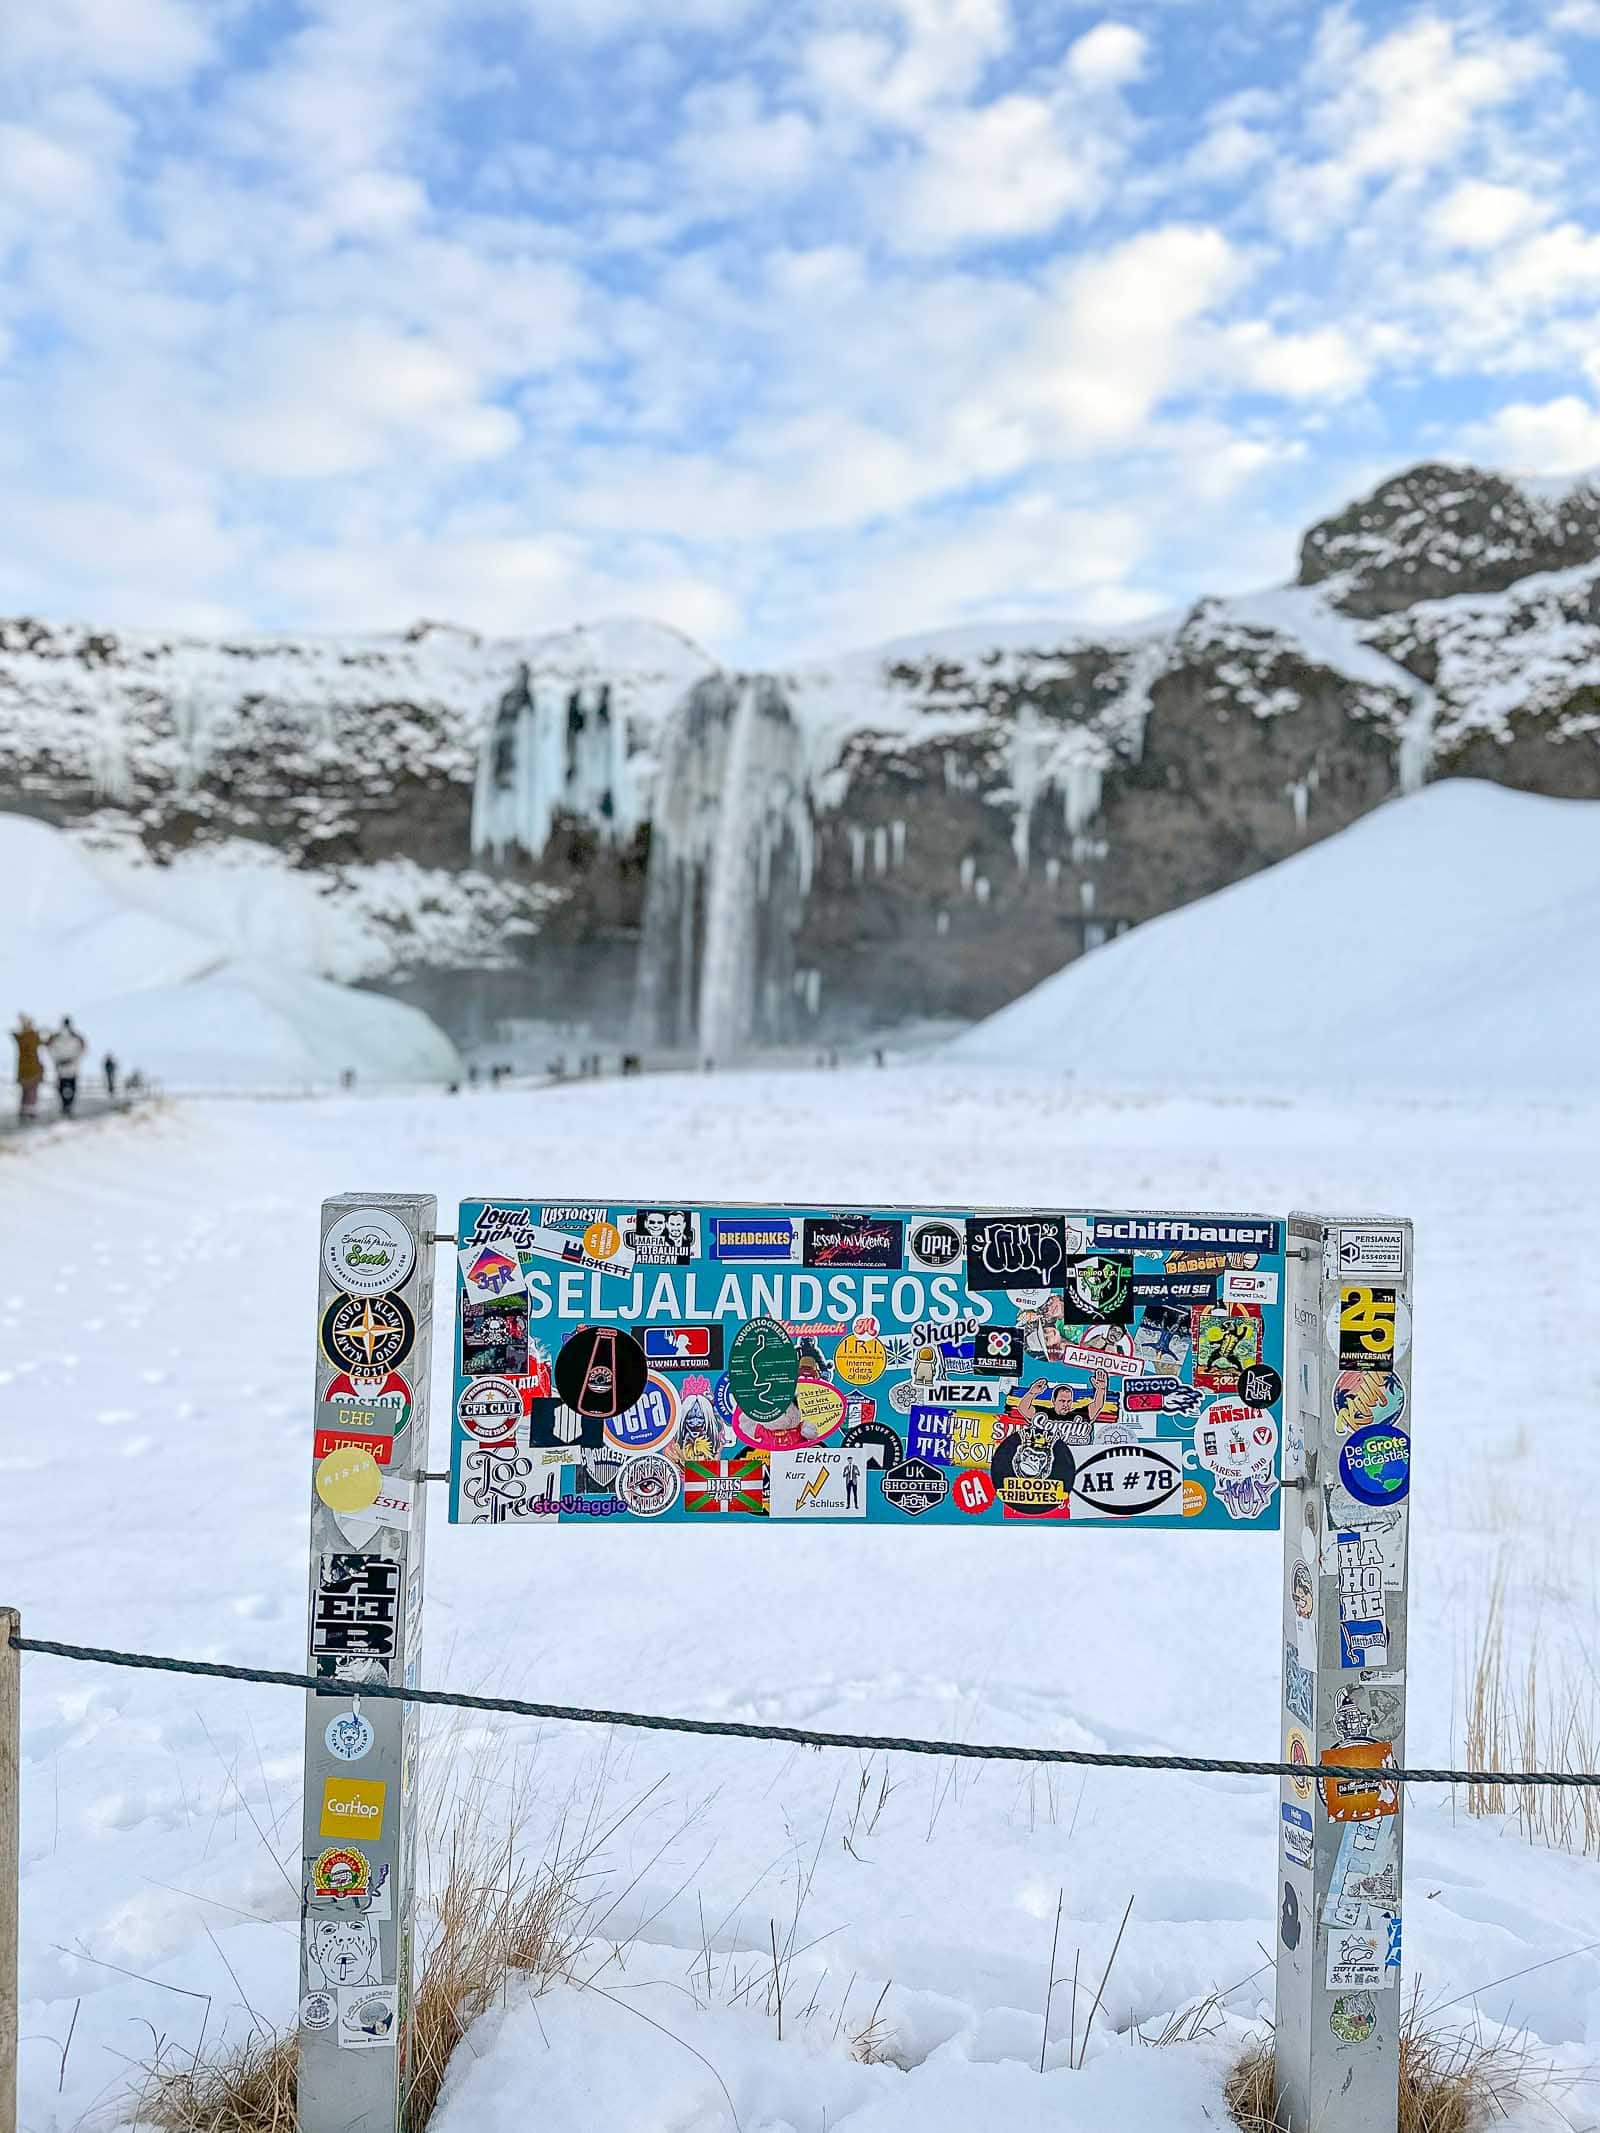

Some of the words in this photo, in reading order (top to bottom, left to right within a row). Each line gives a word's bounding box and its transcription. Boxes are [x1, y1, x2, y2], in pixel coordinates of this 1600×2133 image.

[476, 1205, 530, 1230] Loyal
[719, 1231, 790, 1246] BREADCAKES
[1096, 1221, 1269, 1244] schiffbauer
[1355, 1235, 1401, 1243] PERSIANAS
[345, 1244, 390, 1266] Seeds
[527, 1270, 994, 1325] SELJALANDSFOSS
[336, 1302, 361, 1329] KOVO
[374, 1301, 400, 1327] KLAN
[913, 1318, 977, 1347] Shape
[1340, 1352, 1392, 1360] ANNIVERSARY
[354, 1366, 384, 1377] 2017
[929, 1385, 992, 1402] MEZA
[339, 1409, 375, 1426] CHE
[465, 1404, 487, 1415] CFR
[489, 1403, 516, 1414] CLUJ
[1345, 1445, 1363, 1458] De
[1366, 1436, 1408, 1453] Grote
[795, 1452, 841, 1464] Elektro
[1347, 1448, 1410, 1470] Podcastlas
[785, 1471, 806, 1480] Kurz
[905, 1466, 925, 1478] UK
[1209, 1460, 1243, 1478] VARESE
[884, 1480, 945, 1492] SHOOTERS
[1007, 1480, 1059, 1491] BLOODY
[1082, 1472, 1115, 1493] AH
[1123, 1469, 1173, 1492] #78
[810, 1499, 845, 1508] Schluss
[327, 1798, 379, 1819] CarHop
